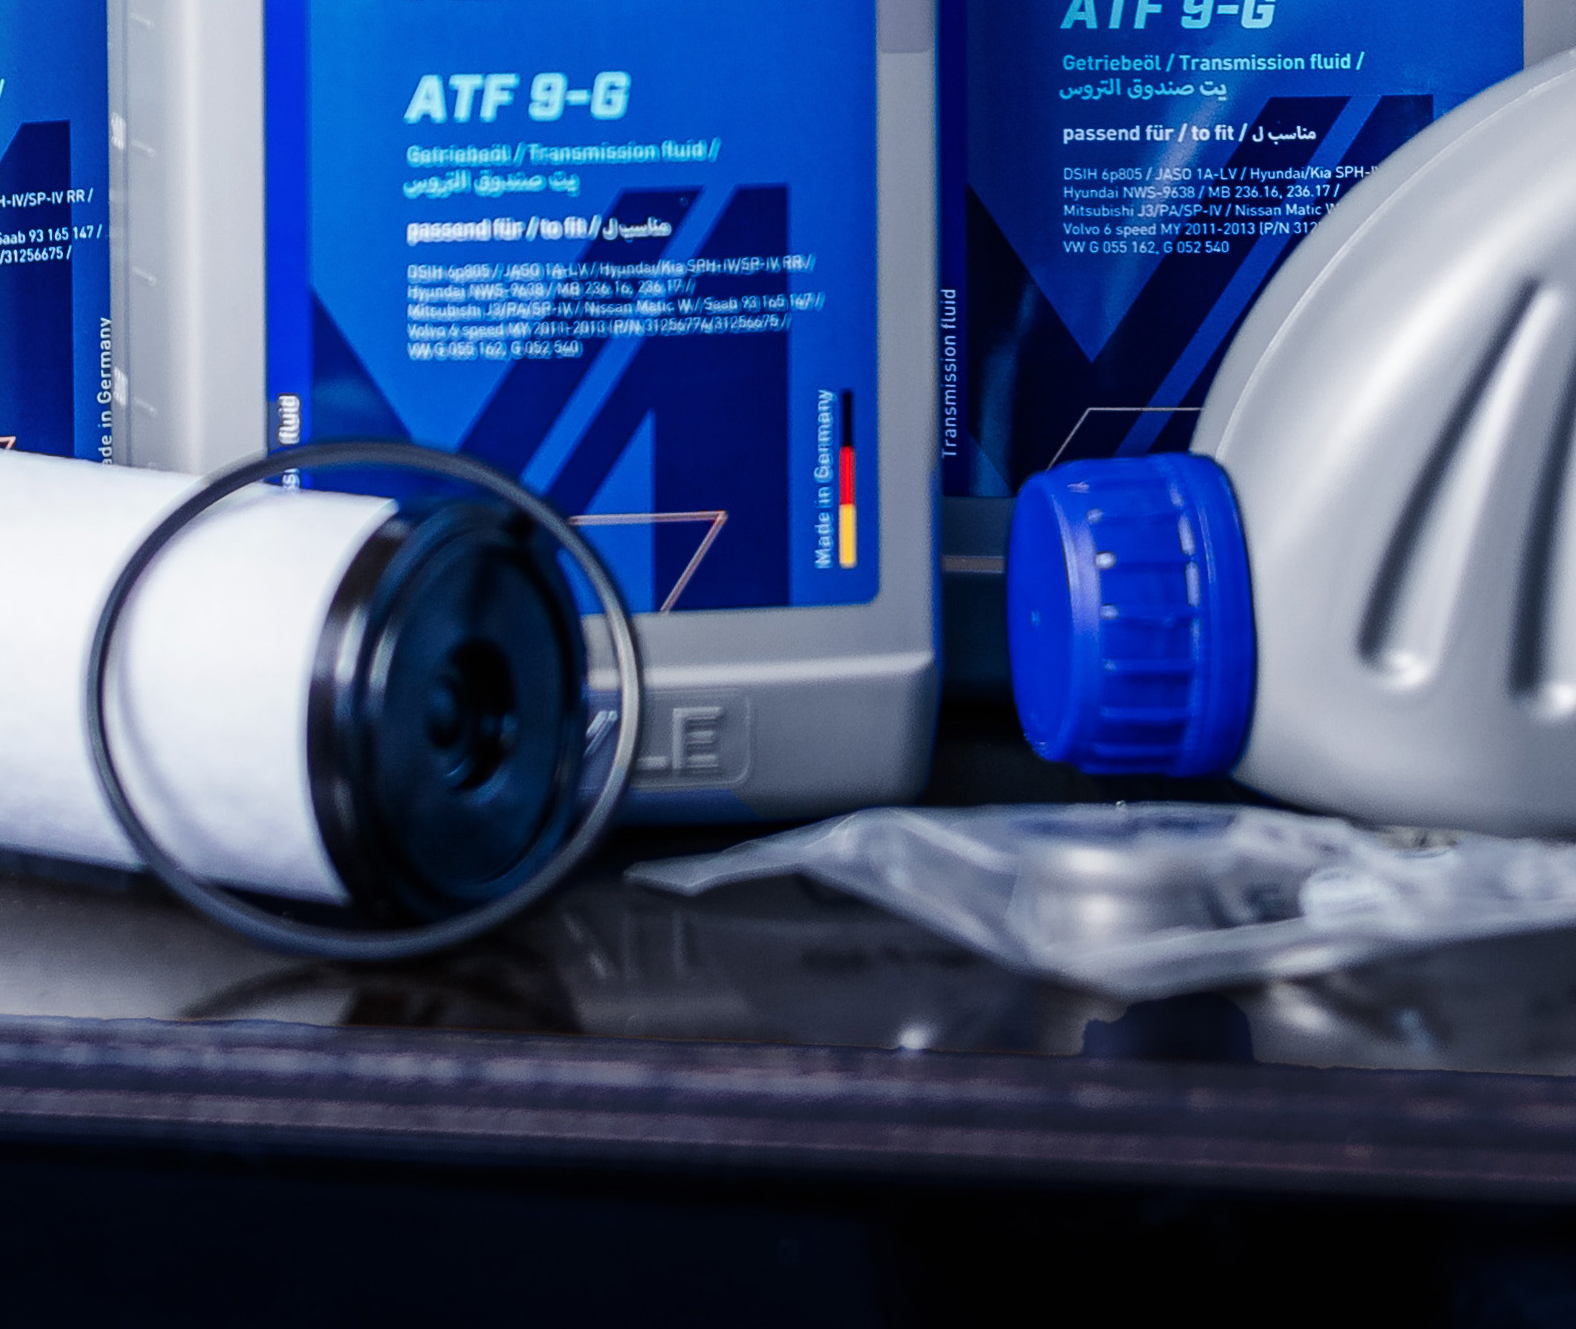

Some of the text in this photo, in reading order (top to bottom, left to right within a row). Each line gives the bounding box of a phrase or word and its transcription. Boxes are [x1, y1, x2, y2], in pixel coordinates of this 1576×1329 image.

[1062, 52, 1352, 71] Getriebeöl Transmission fluid
[403, 71, 631, 124] ATF 9-G
[1059, 78, 1121, 100] التروس
[1127, 79, 1194, 99] صندوق
[1063, 124, 1234, 144] passend für to fit
[1268, 126, 1316, 145] مناسب
[528, 141, 657, 165] Transmission
[661, 138, 706, 162] fluid
[1063, 168, 1097, 181] DSIH
[1101, 167, 1143, 183] 6p805
[1155, 167, 1192, 181] JASO
[1197, 167, 1237, 180] 1A-LV
[1250, 166, 1332, 183] Hyundai/Kia
[67, 189, 85, 204] RR
[1063, 185, 1330, 201] Hyundai NWS-9638 MB 236.16, 236.17
[1063, 203, 1134, 217] Mitsubishi
[1137, 203, 1222, 218] J3/PA/SP-IV
[1235, 203, 1282, 216] Nissan
[1285, 203, 1322, 216] Matic
[29, 229, 44, 243] 93
[47, 227, 69, 242] 165
[407, 216, 588, 246] passend für to fit
[1063, 222, 1100, 235] Volvo
[1103, 222, 1112, 235] 6
[1115, 222, 1157, 238] speed
[1161, 223, 1181, 235] MY
[1185, 222, 1256, 235] 2011-2013
[1063, 240, 1230, 255] VW G 055 162, G 052 540
[941, 288, 957, 458] Transmission fluid
[97, 317, 113, 468] ade in Germany
[277, 394, 300, 445] fluid
[814, 389, 836, 569] Made in Germany
